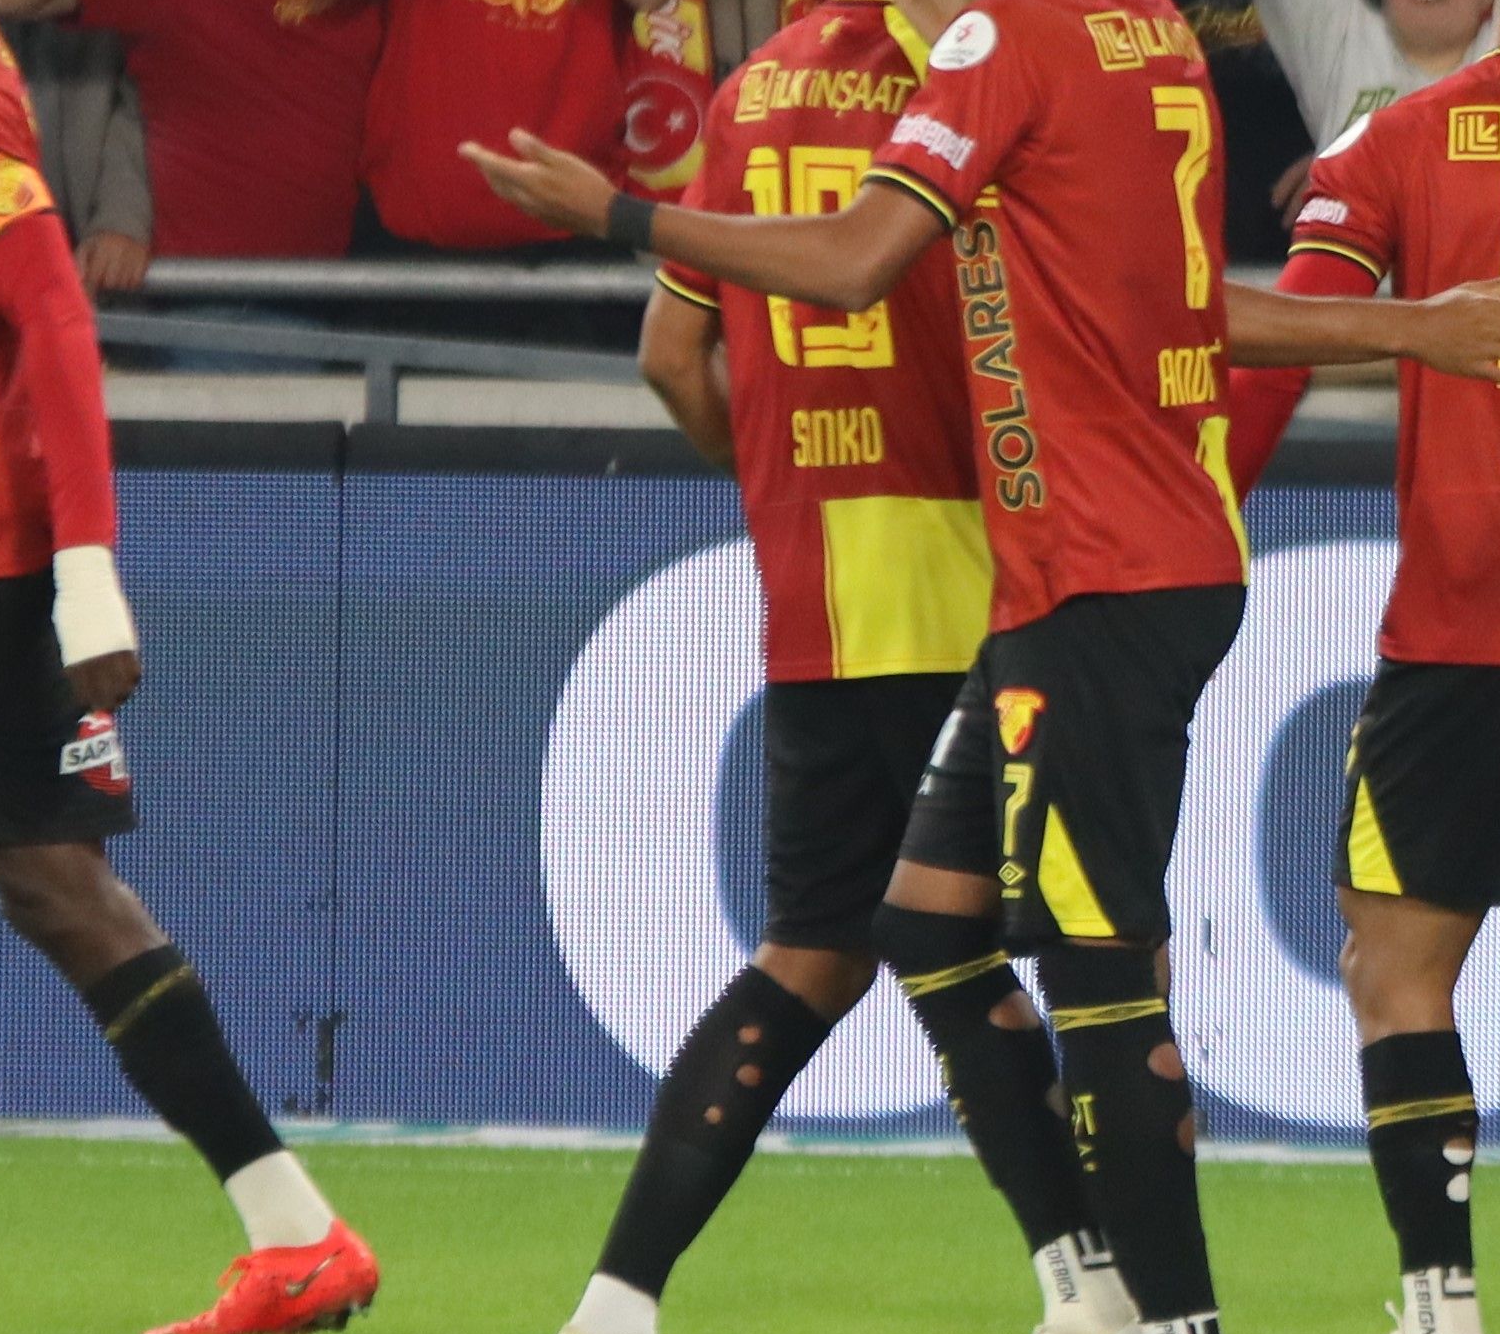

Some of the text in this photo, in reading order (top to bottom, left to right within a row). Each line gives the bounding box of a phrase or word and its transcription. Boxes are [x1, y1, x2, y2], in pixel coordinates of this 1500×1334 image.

[1150, 86, 1212, 310] 7
[953, 218, 1046, 513] SOLARES
[1002, 763, 1035, 858] 7
